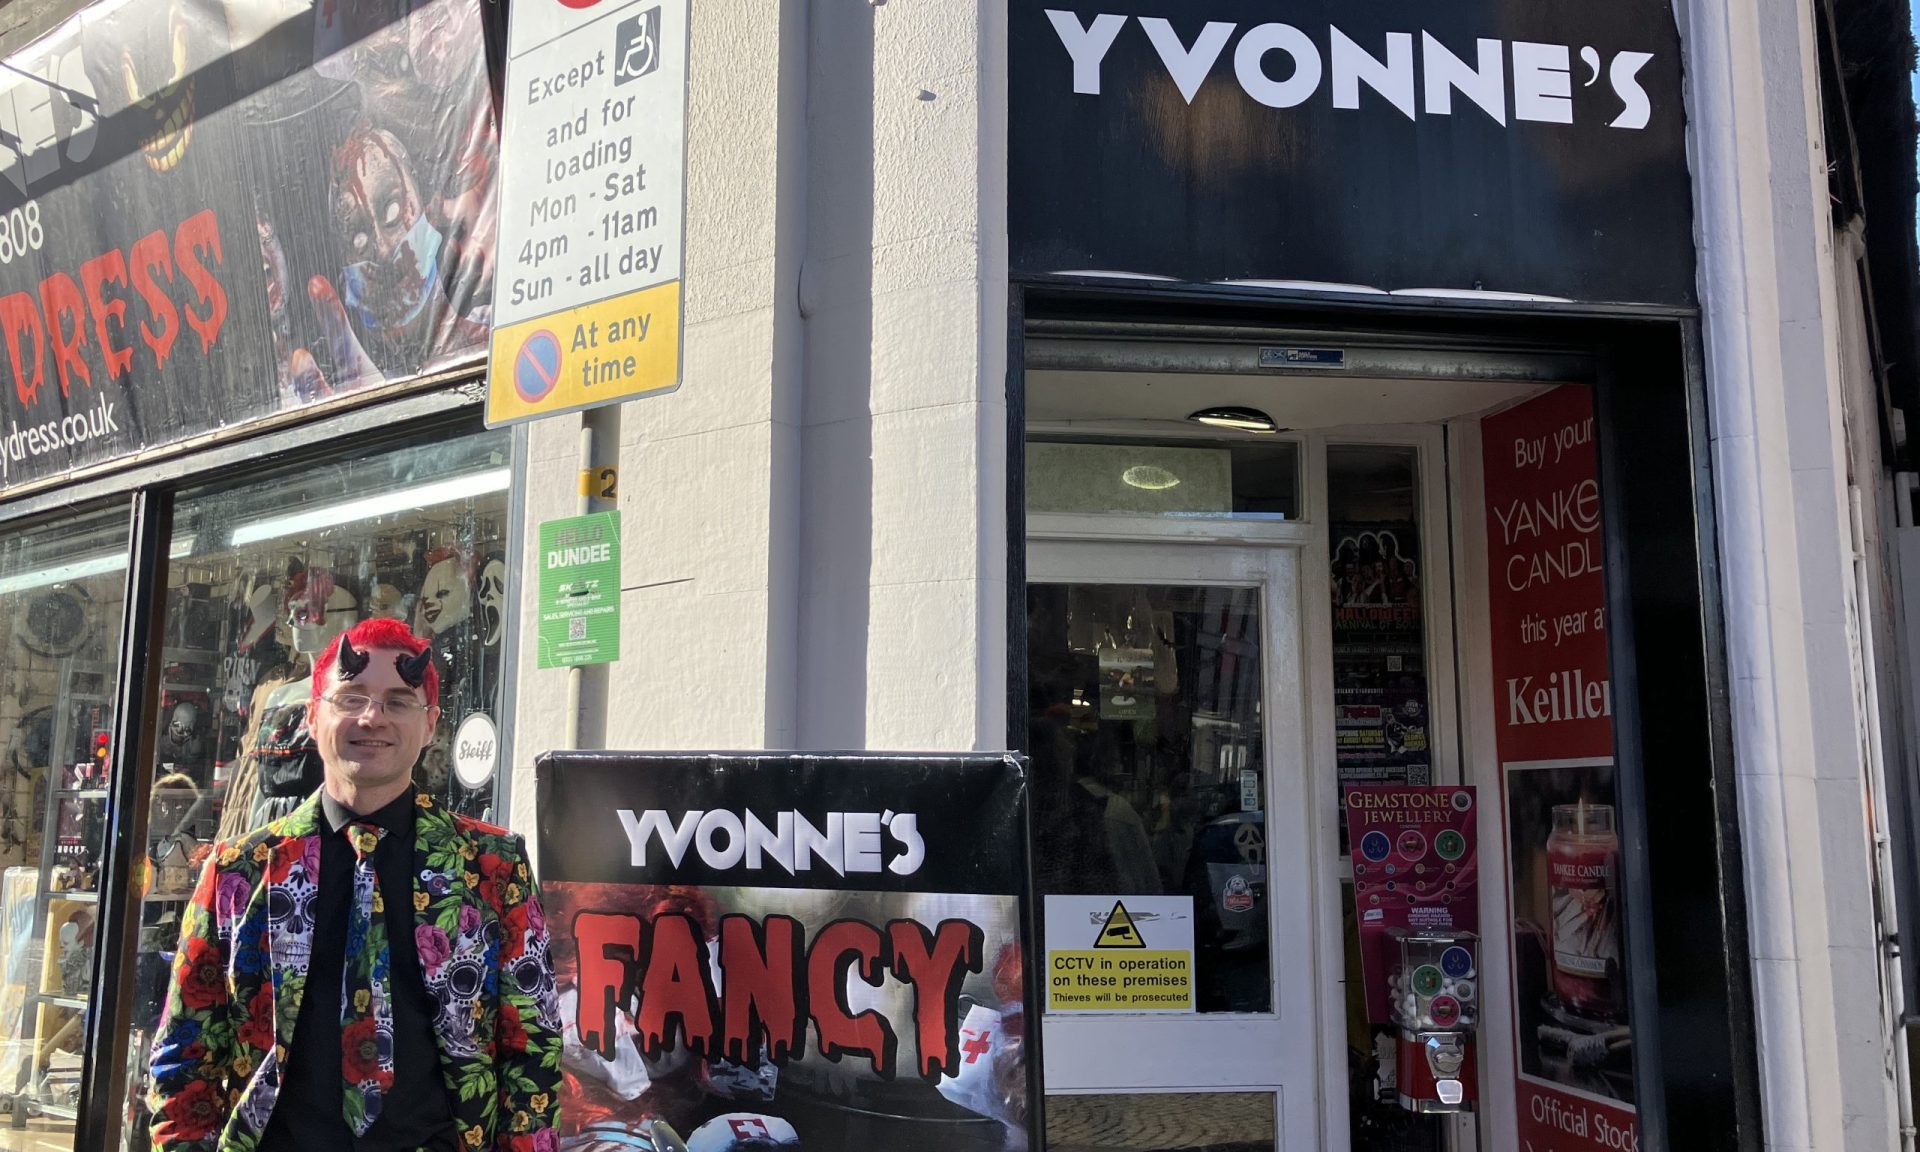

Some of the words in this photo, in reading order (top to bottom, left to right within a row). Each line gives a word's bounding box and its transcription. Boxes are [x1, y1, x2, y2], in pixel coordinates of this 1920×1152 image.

[528, 50, 605, 105] Except
[1044, 9, 1654, 129] YVONNE'S
[546, 108, 588, 148] and
[601, 95, 636, 127] for
[546, 136, 633, 184] loading
[530, 193, 576, 227] Mon
[603, 163, 647, 202] Sat
[0, 199, 44, 264] 808
[518, 234, 568, 268] 4pm
[602, 205, 657, 241] 11am
[510, 275, 553, 306] Sun
[579, 252, 610, 287] all
[618, 244, 663, 275] day
[0, 208, 228, 411] DRESS
[571, 321, 599, 353] At
[607, 313, 652, 343] any
[582, 354, 637, 388] time
[1514, 435, 1546, 470] Buy
[1553, 416, 1595, 465] your
[600, 468, 617, 499] 2
[547, 543, 611, 569] DUNDEE
[554, 524, 604, 546] HELLO
[1520, 612, 1548, 644] this
[1553, 610, 1588, 647] year
[458, 739, 493, 761] Steiff
[616, 808, 926, 878] YVONNE'S
[1363, 811, 1453, 826] JEWELLERY
[1053, 976, 1070, 986] on
[1077, 974, 1117, 986] these
[1123, 973, 1188, 988] premises
[1054, 957, 1094, 970] CCTV
[1100, 957, 1112, 970] in
[1119, 957, 1186, 972] operation
[572, 909, 984, 1085] FANCY
[1053, 992, 1091, 1002] Thieves
[1095, 992, 1111, 1002] will
[1115, 992, 1128, 1002] be
[1132, 992, 1189, 1004] prosecuted
[1531, 1094, 1588, 1139] Official
[1594, 1113, 1639, 1152] Stock
